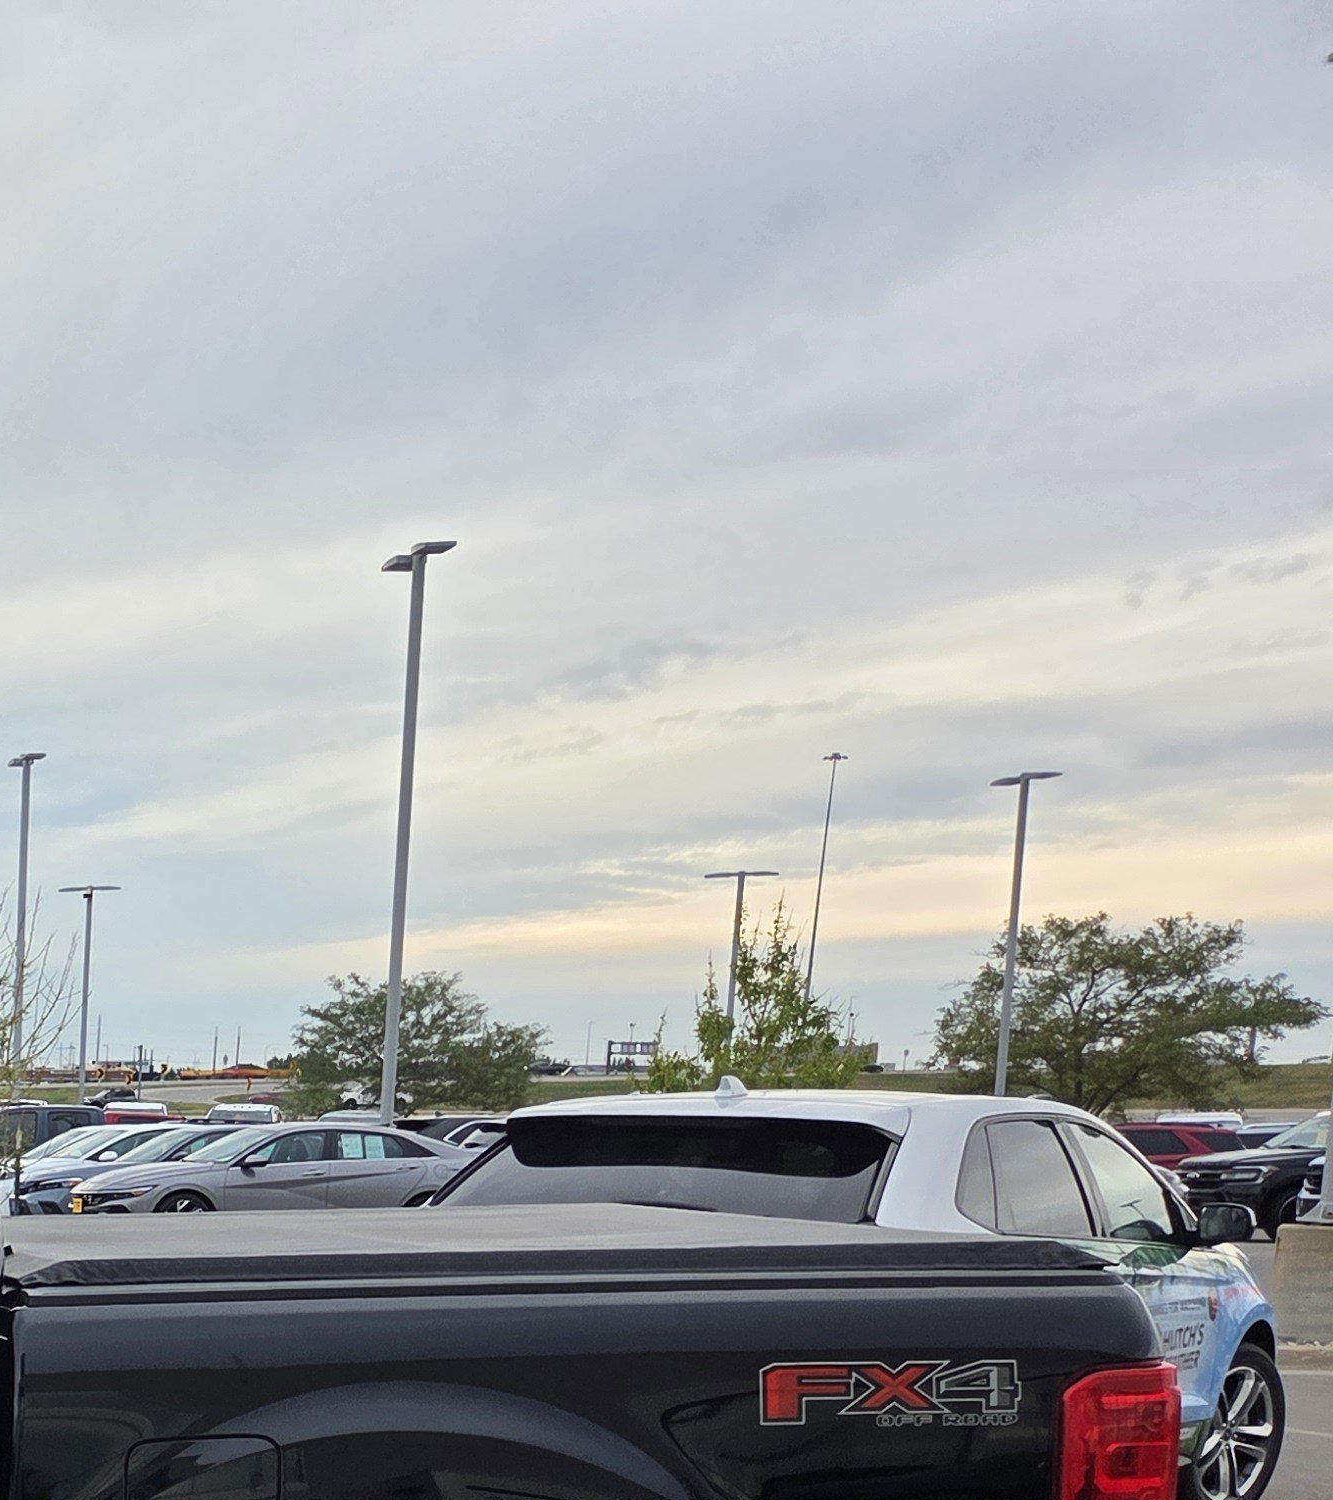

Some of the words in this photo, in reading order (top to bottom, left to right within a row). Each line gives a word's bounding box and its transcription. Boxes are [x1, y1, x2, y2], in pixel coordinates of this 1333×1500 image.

[759, 1360, 1022, 1426] FX4
[876, 1414, 933, 1427] OFF
[941, 1413, 1020, 1427] ROAD
